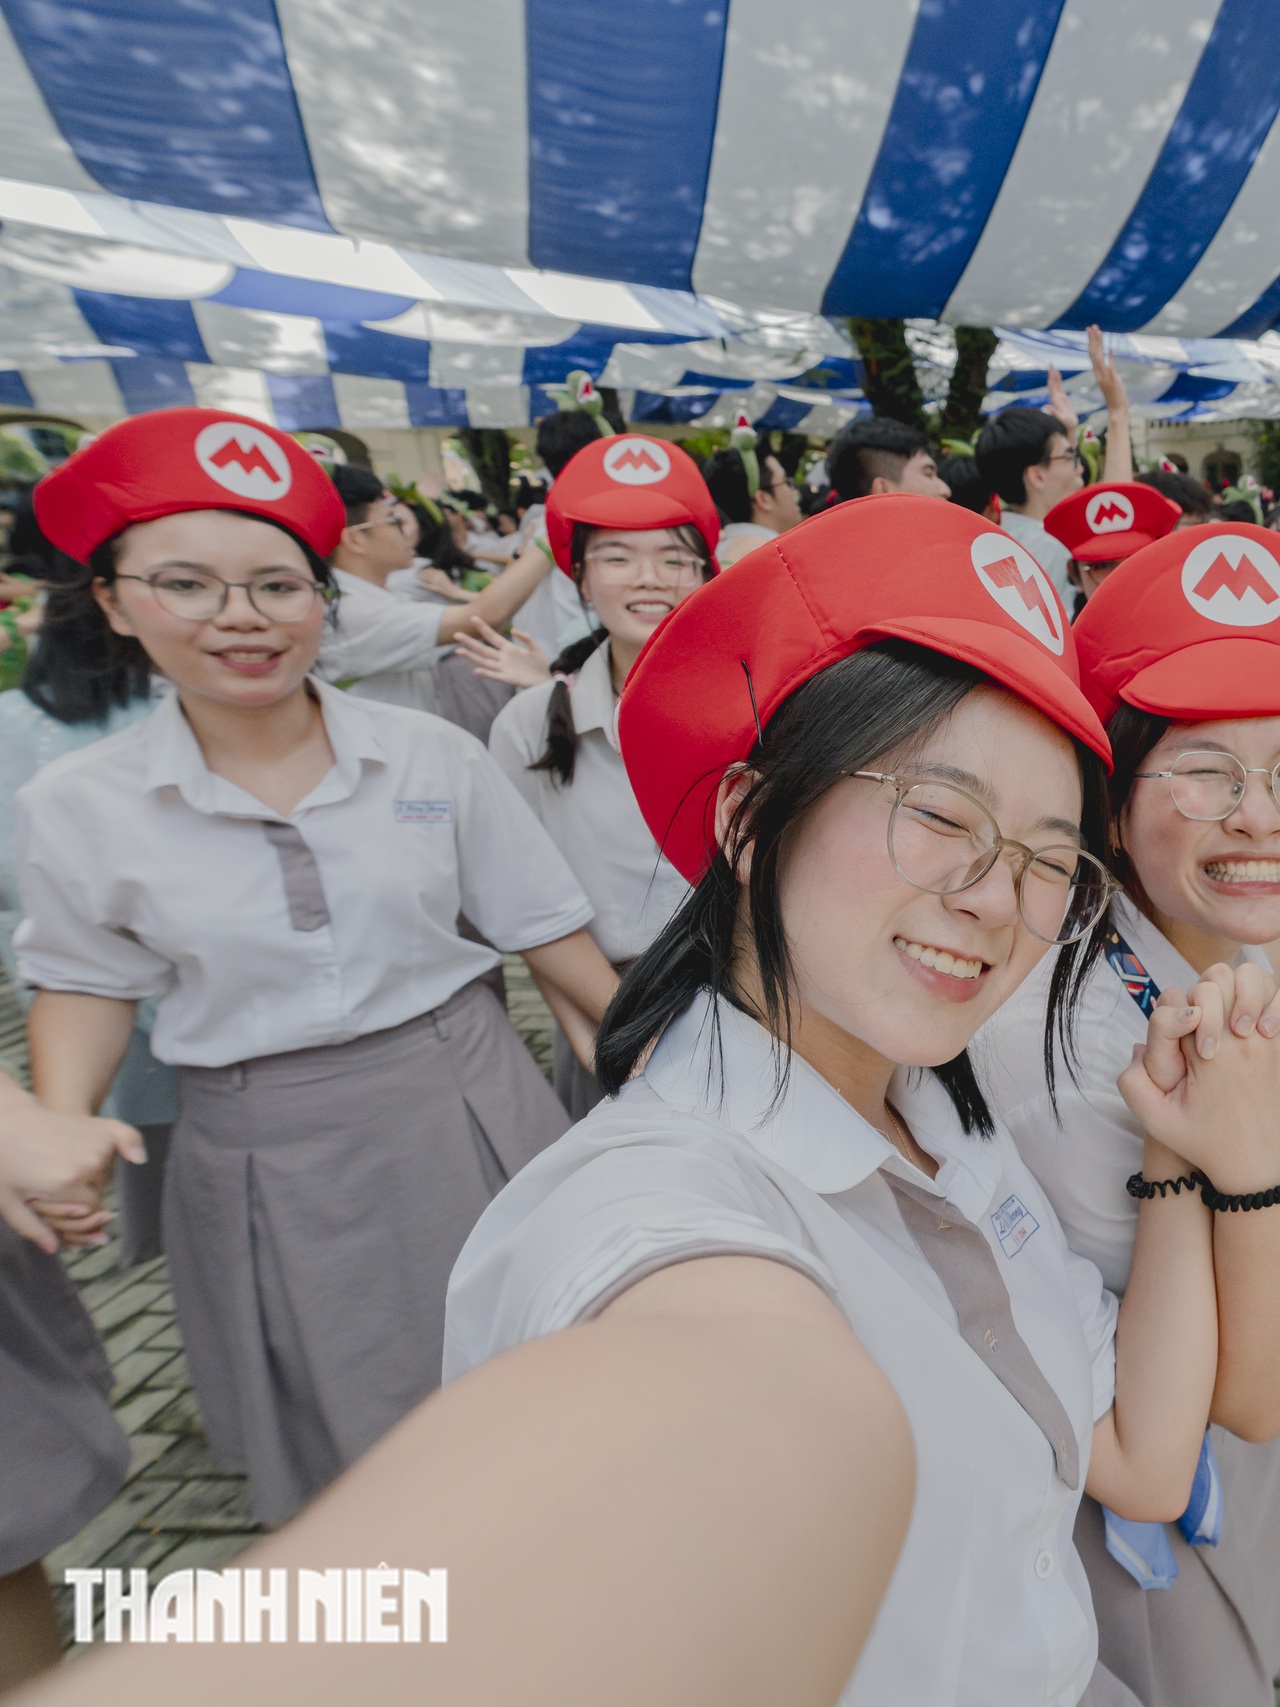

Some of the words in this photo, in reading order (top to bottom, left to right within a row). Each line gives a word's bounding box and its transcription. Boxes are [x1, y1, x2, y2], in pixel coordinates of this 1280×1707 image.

[208, 437, 281, 483] M
[612, 449, 661, 472] M
[1093, 501, 1128, 525] M
[981, 555, 1061, 641] M
[1193, 552, 1280, 605] M
